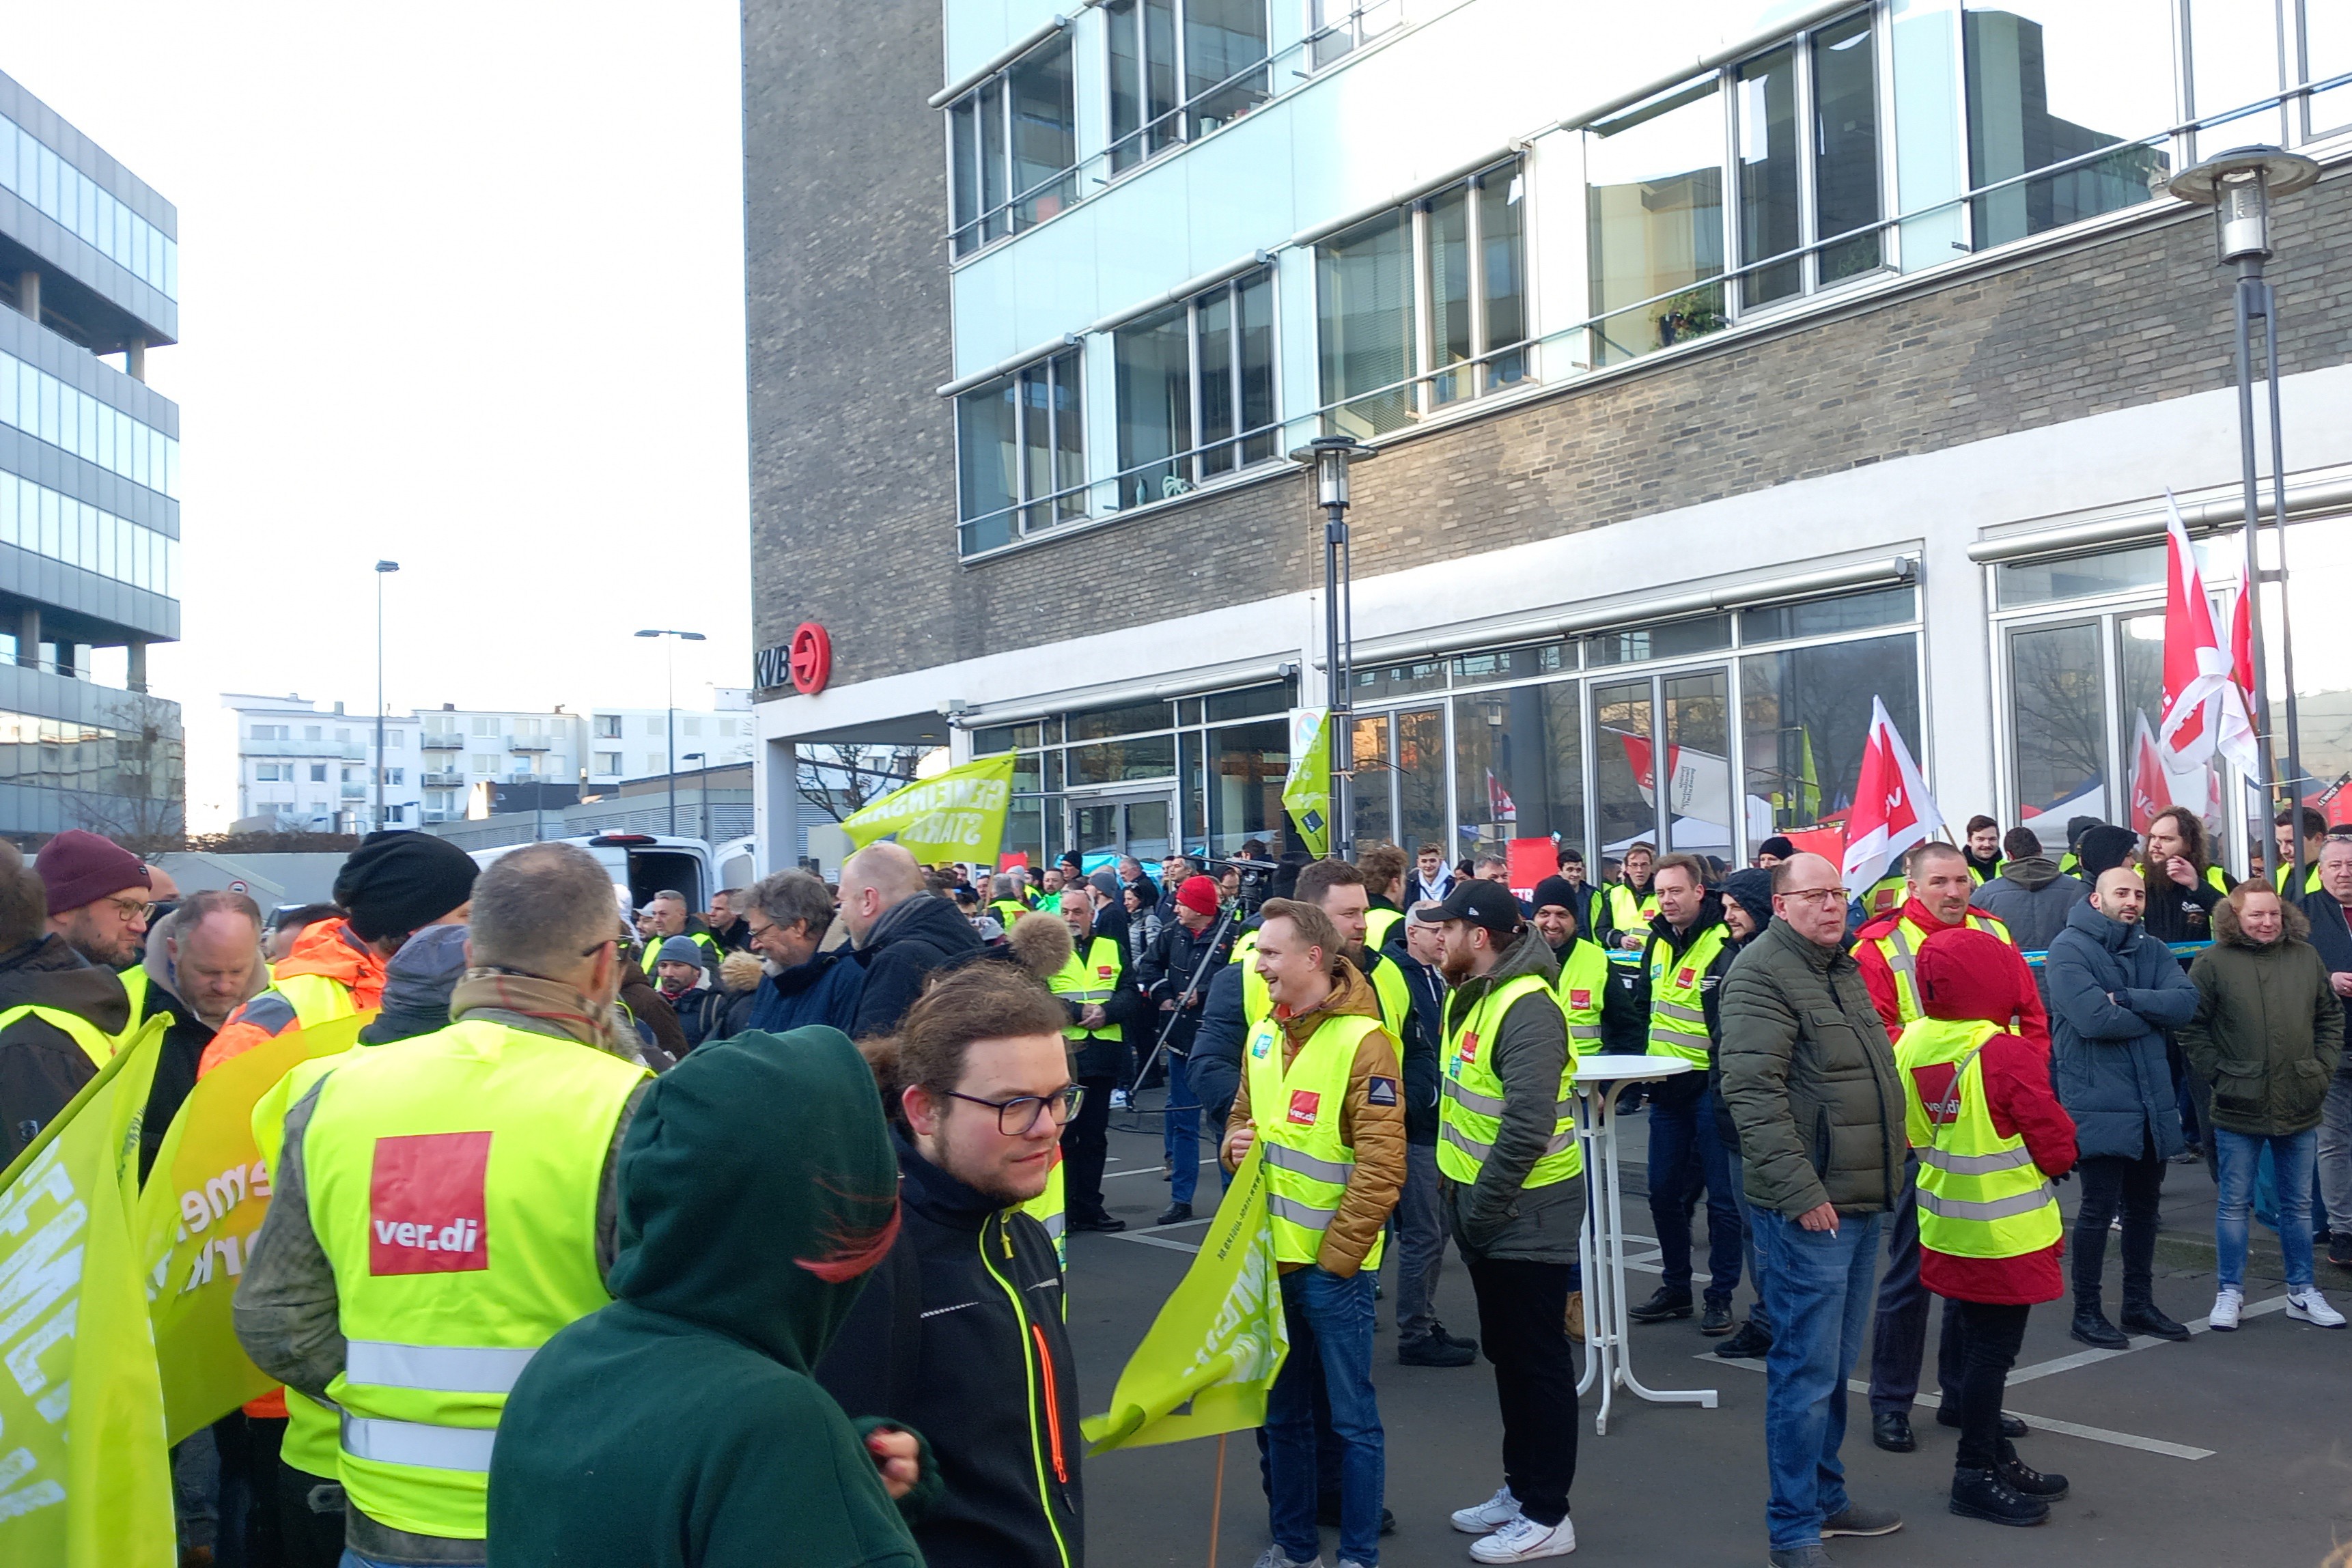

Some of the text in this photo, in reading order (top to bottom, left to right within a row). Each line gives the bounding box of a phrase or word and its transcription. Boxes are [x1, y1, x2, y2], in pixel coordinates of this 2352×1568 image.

[753, 645, 790, 689] KVB
[1289, 1108, 1317, 1122] ver.di
[374, 1218, 478, 1252] ver.di
